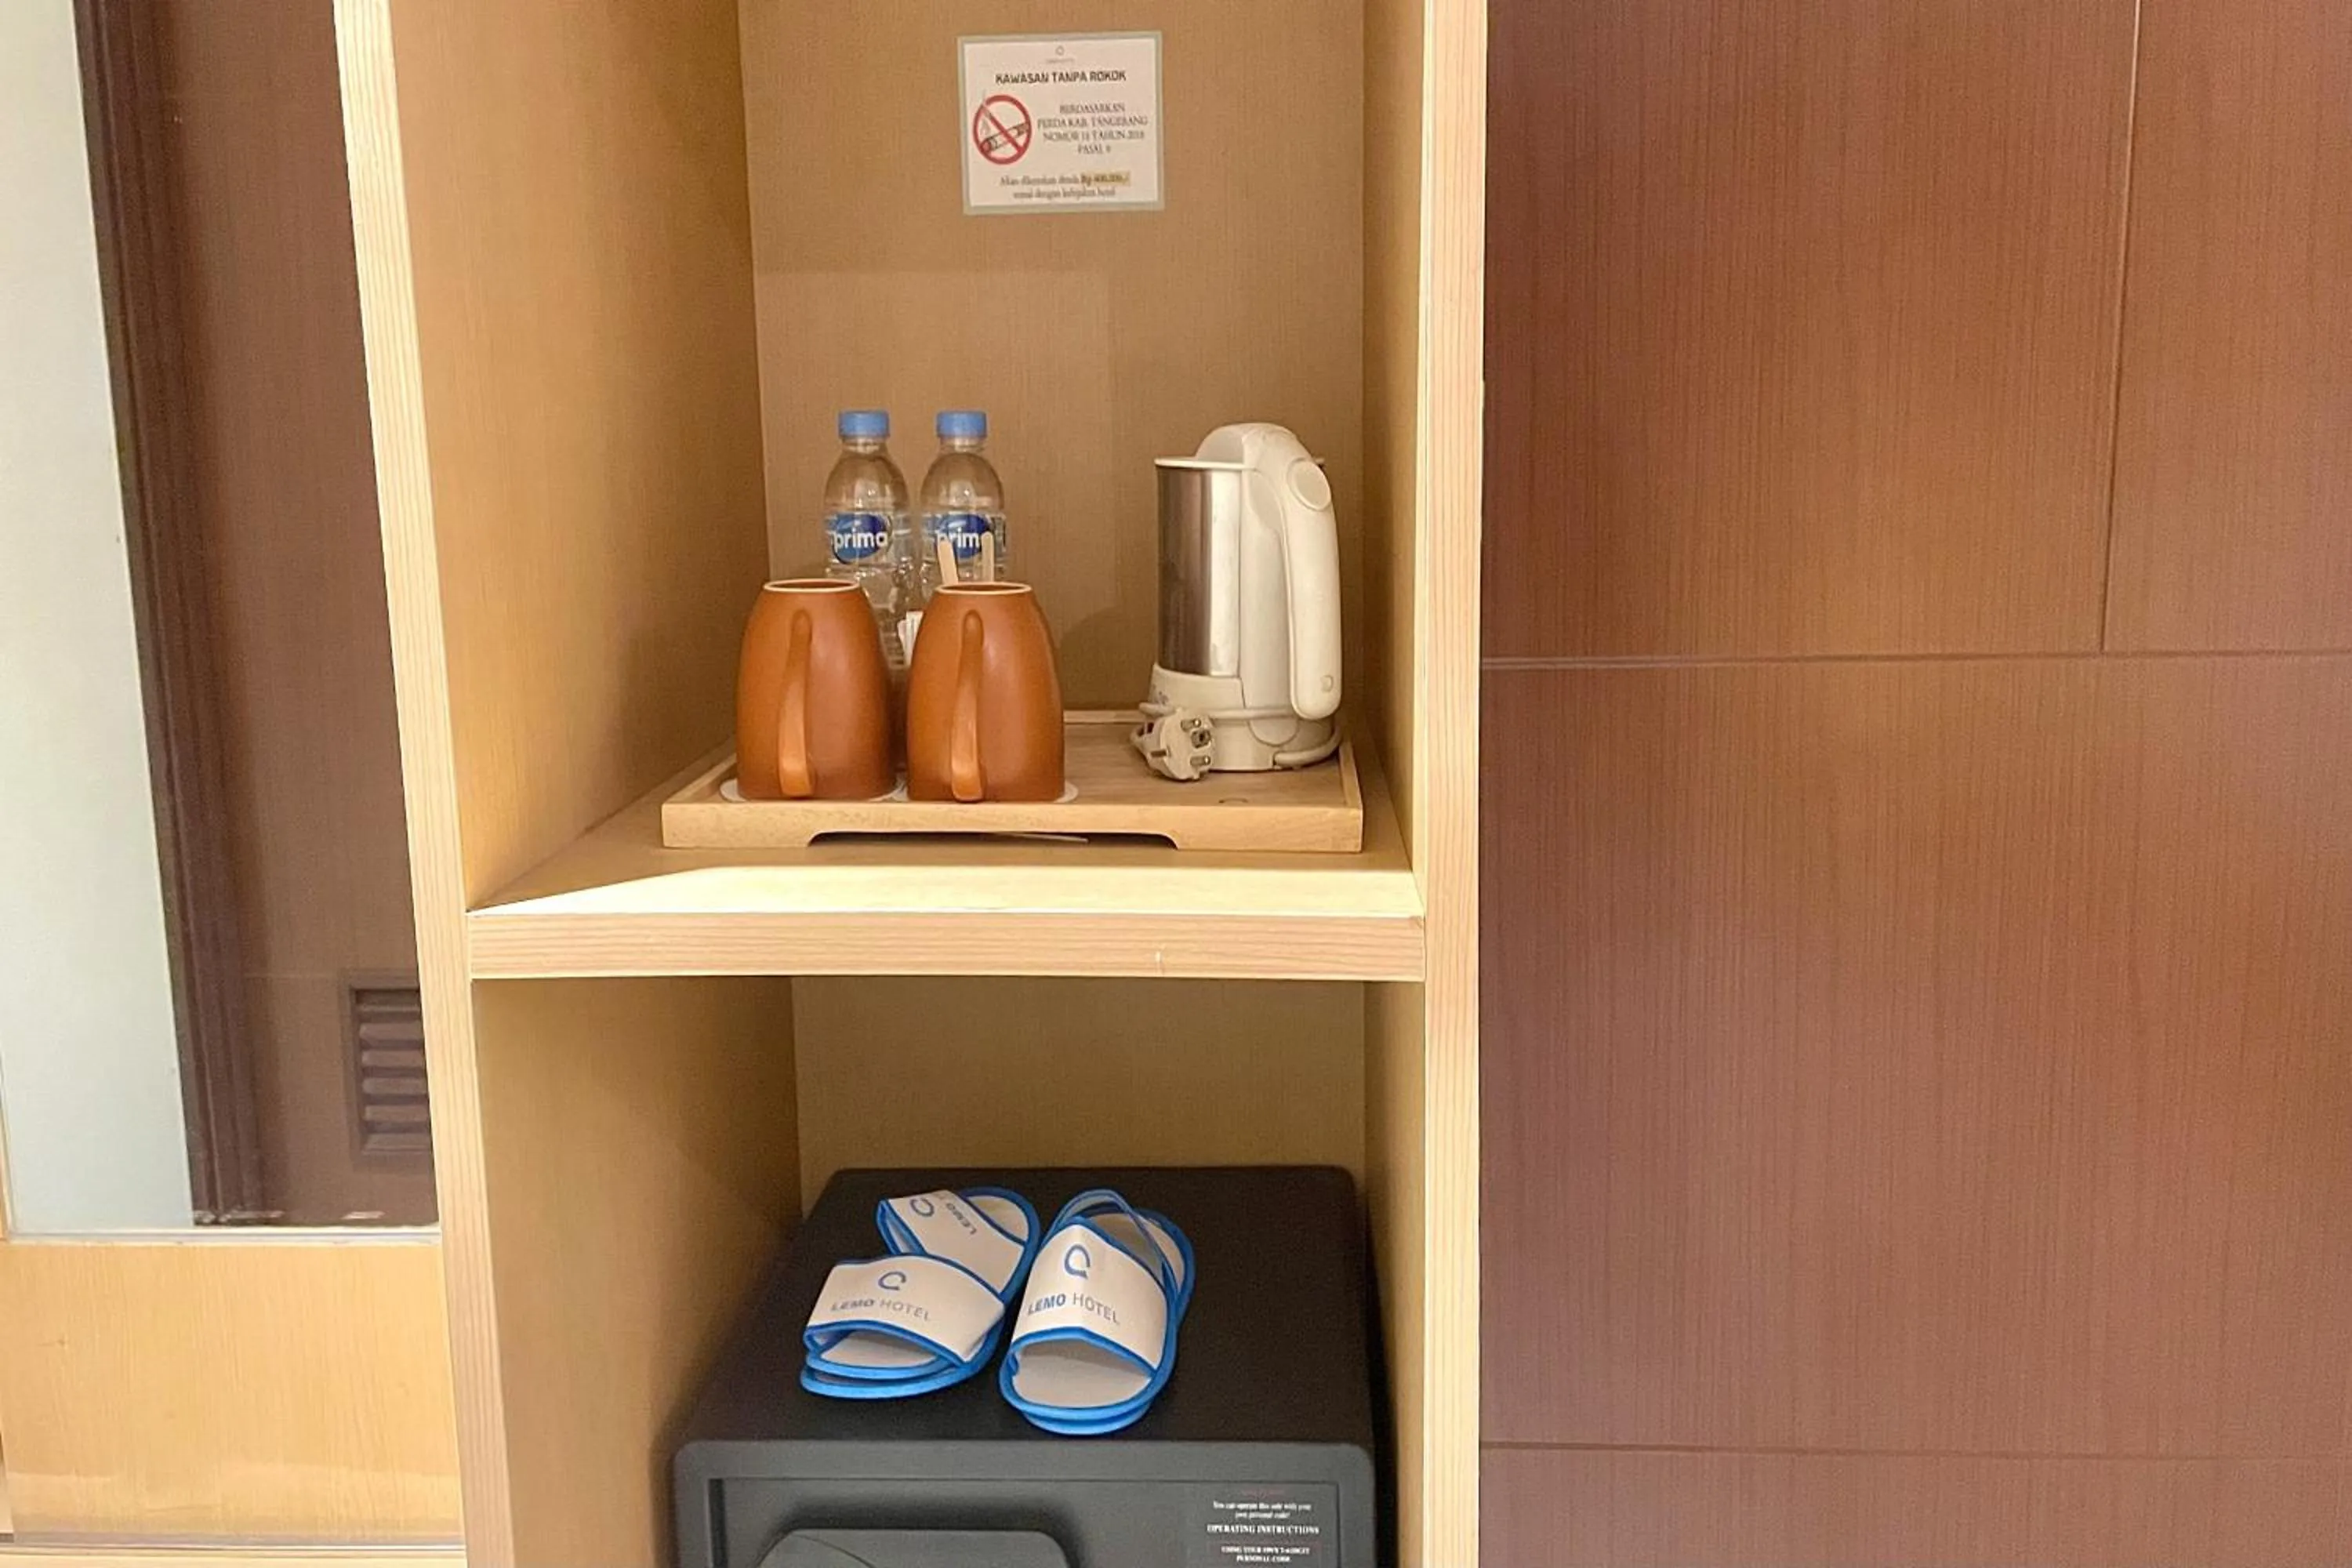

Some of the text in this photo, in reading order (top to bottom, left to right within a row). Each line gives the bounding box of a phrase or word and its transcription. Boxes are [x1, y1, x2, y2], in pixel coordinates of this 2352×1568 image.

[995, 70, 1127, 84] KAWASAN TANPA ROKOK
[1091, 115, 1149, 127] TANGERANG
[833, 528, 888, 552] prima
[936, 527, 980, 549] rim
[830, 1298, 931, 1321] LEMO HOTEL
[1028, 1291, 1120, 1326] LEMO HOTEL
[1207, 1524, 1320, 1535] OPERATING INSTRUCTIONS
